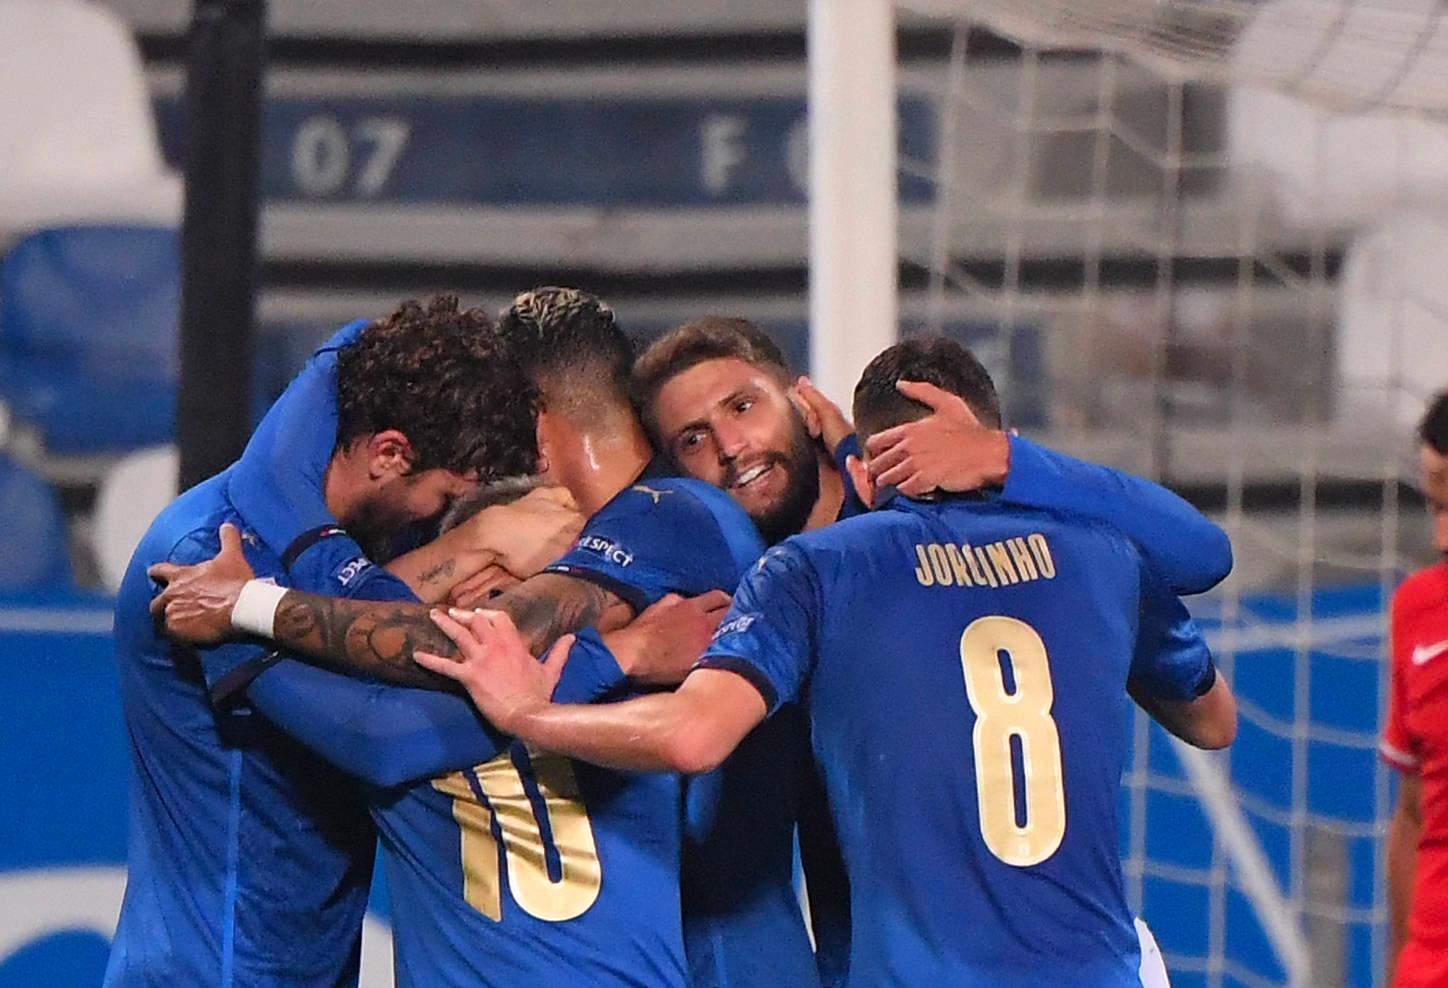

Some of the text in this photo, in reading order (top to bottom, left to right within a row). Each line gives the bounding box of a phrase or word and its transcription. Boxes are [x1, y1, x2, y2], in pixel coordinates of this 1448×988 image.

[291, 116, 411, 196] 07
[959, 615, 1067, 868] 8
[430, 750, 603, 923] 10
